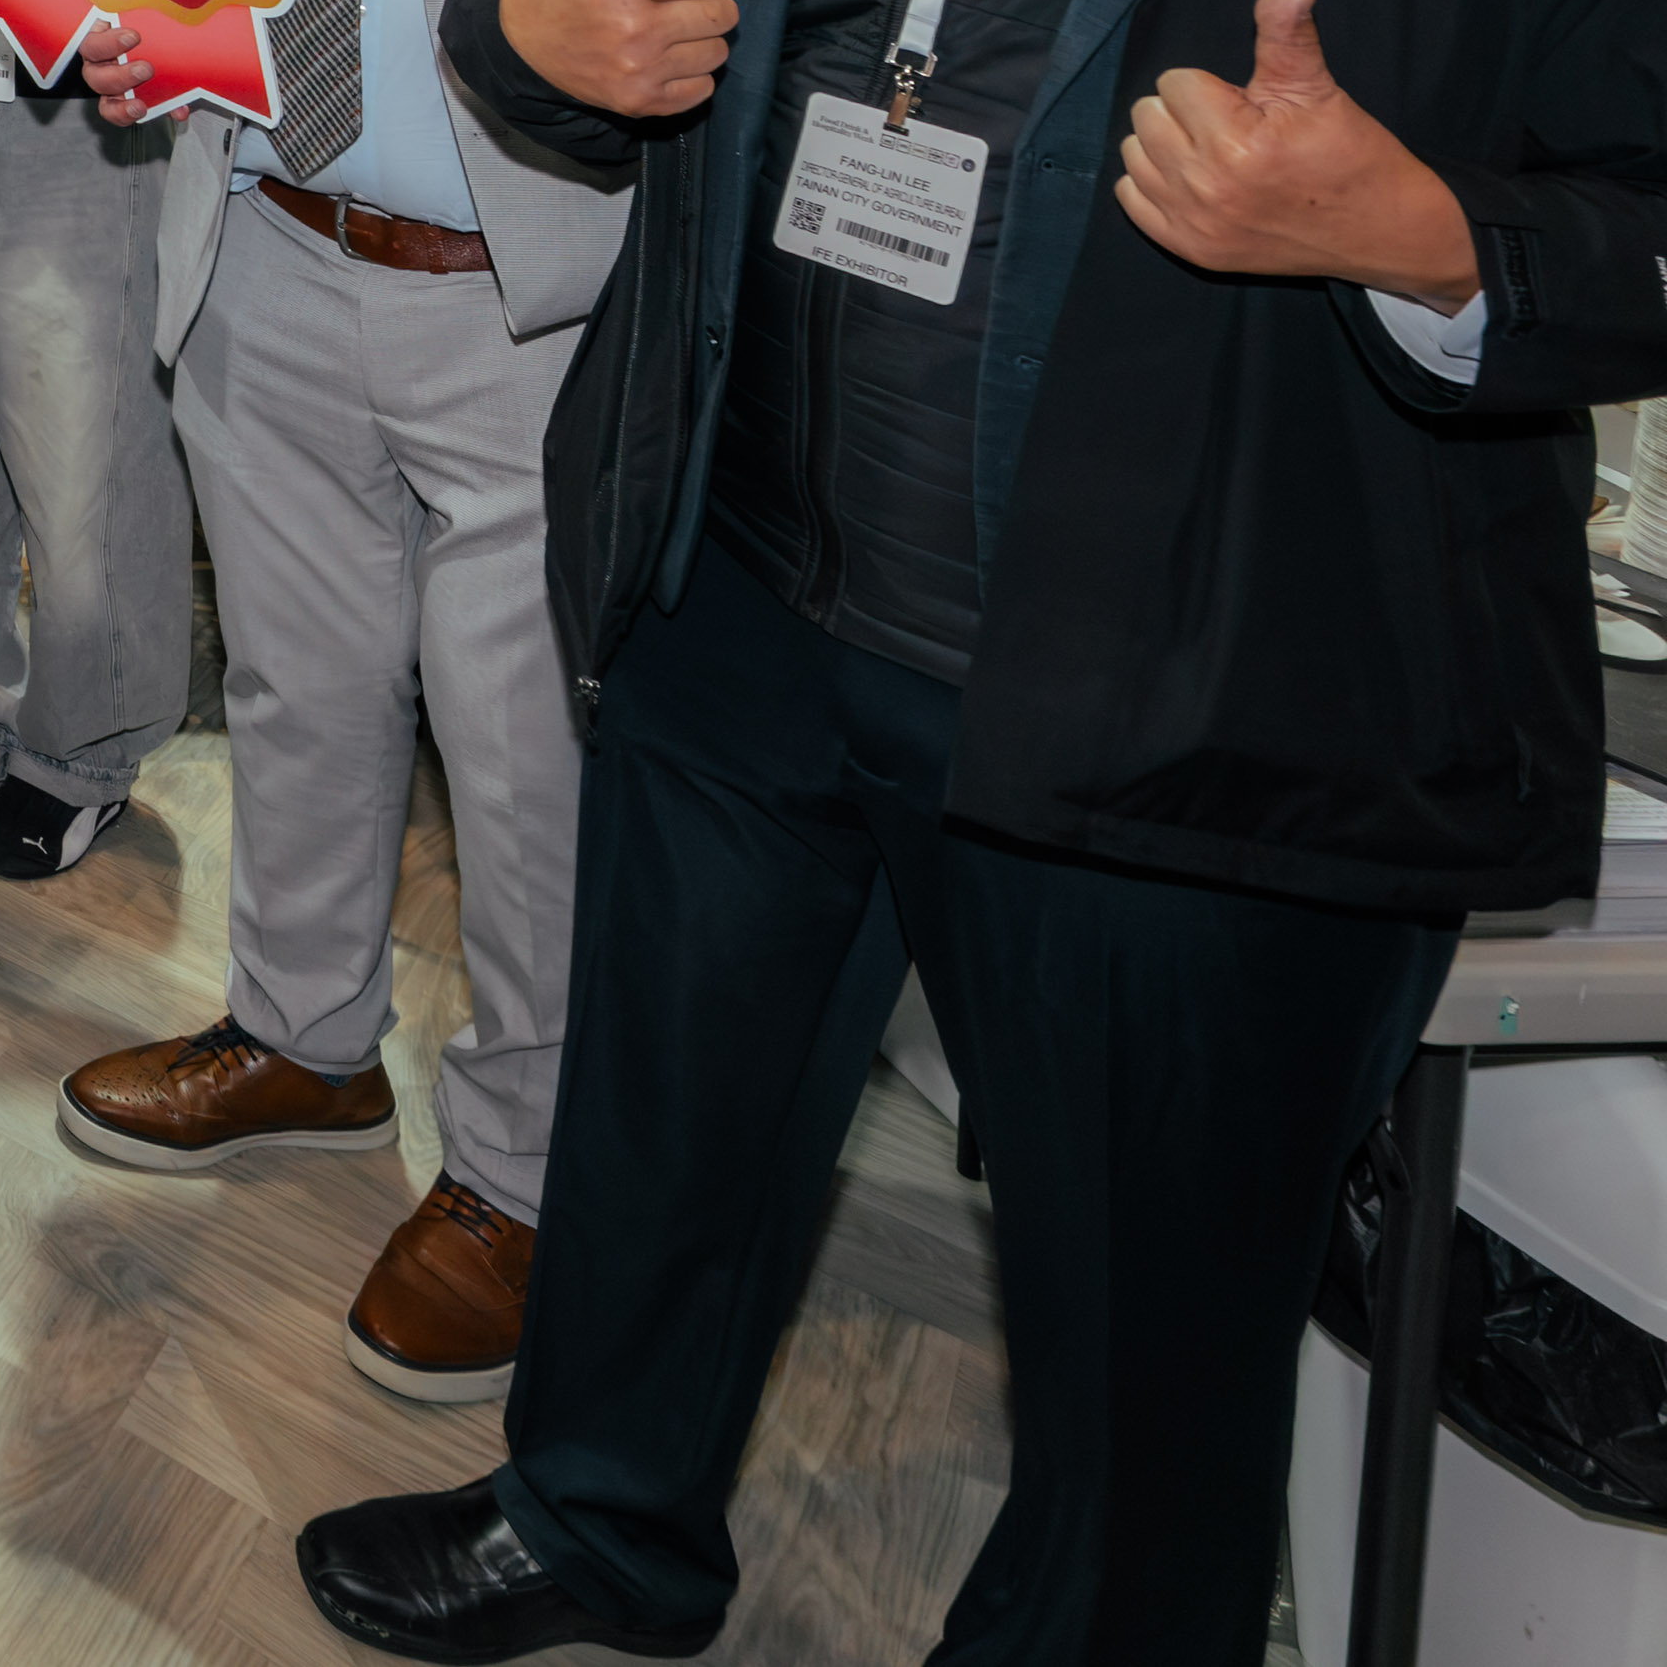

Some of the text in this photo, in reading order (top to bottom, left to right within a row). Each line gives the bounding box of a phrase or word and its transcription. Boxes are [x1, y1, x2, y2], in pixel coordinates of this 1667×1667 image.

[839, 155, 931, 192] FANG-LIN LEE
[795, 175, 963, 237] TAINAN CITY GOVERNMENT
[812, 245, 833, 262] IFE
[835, 253, 909, 287] EXHIBITOR
